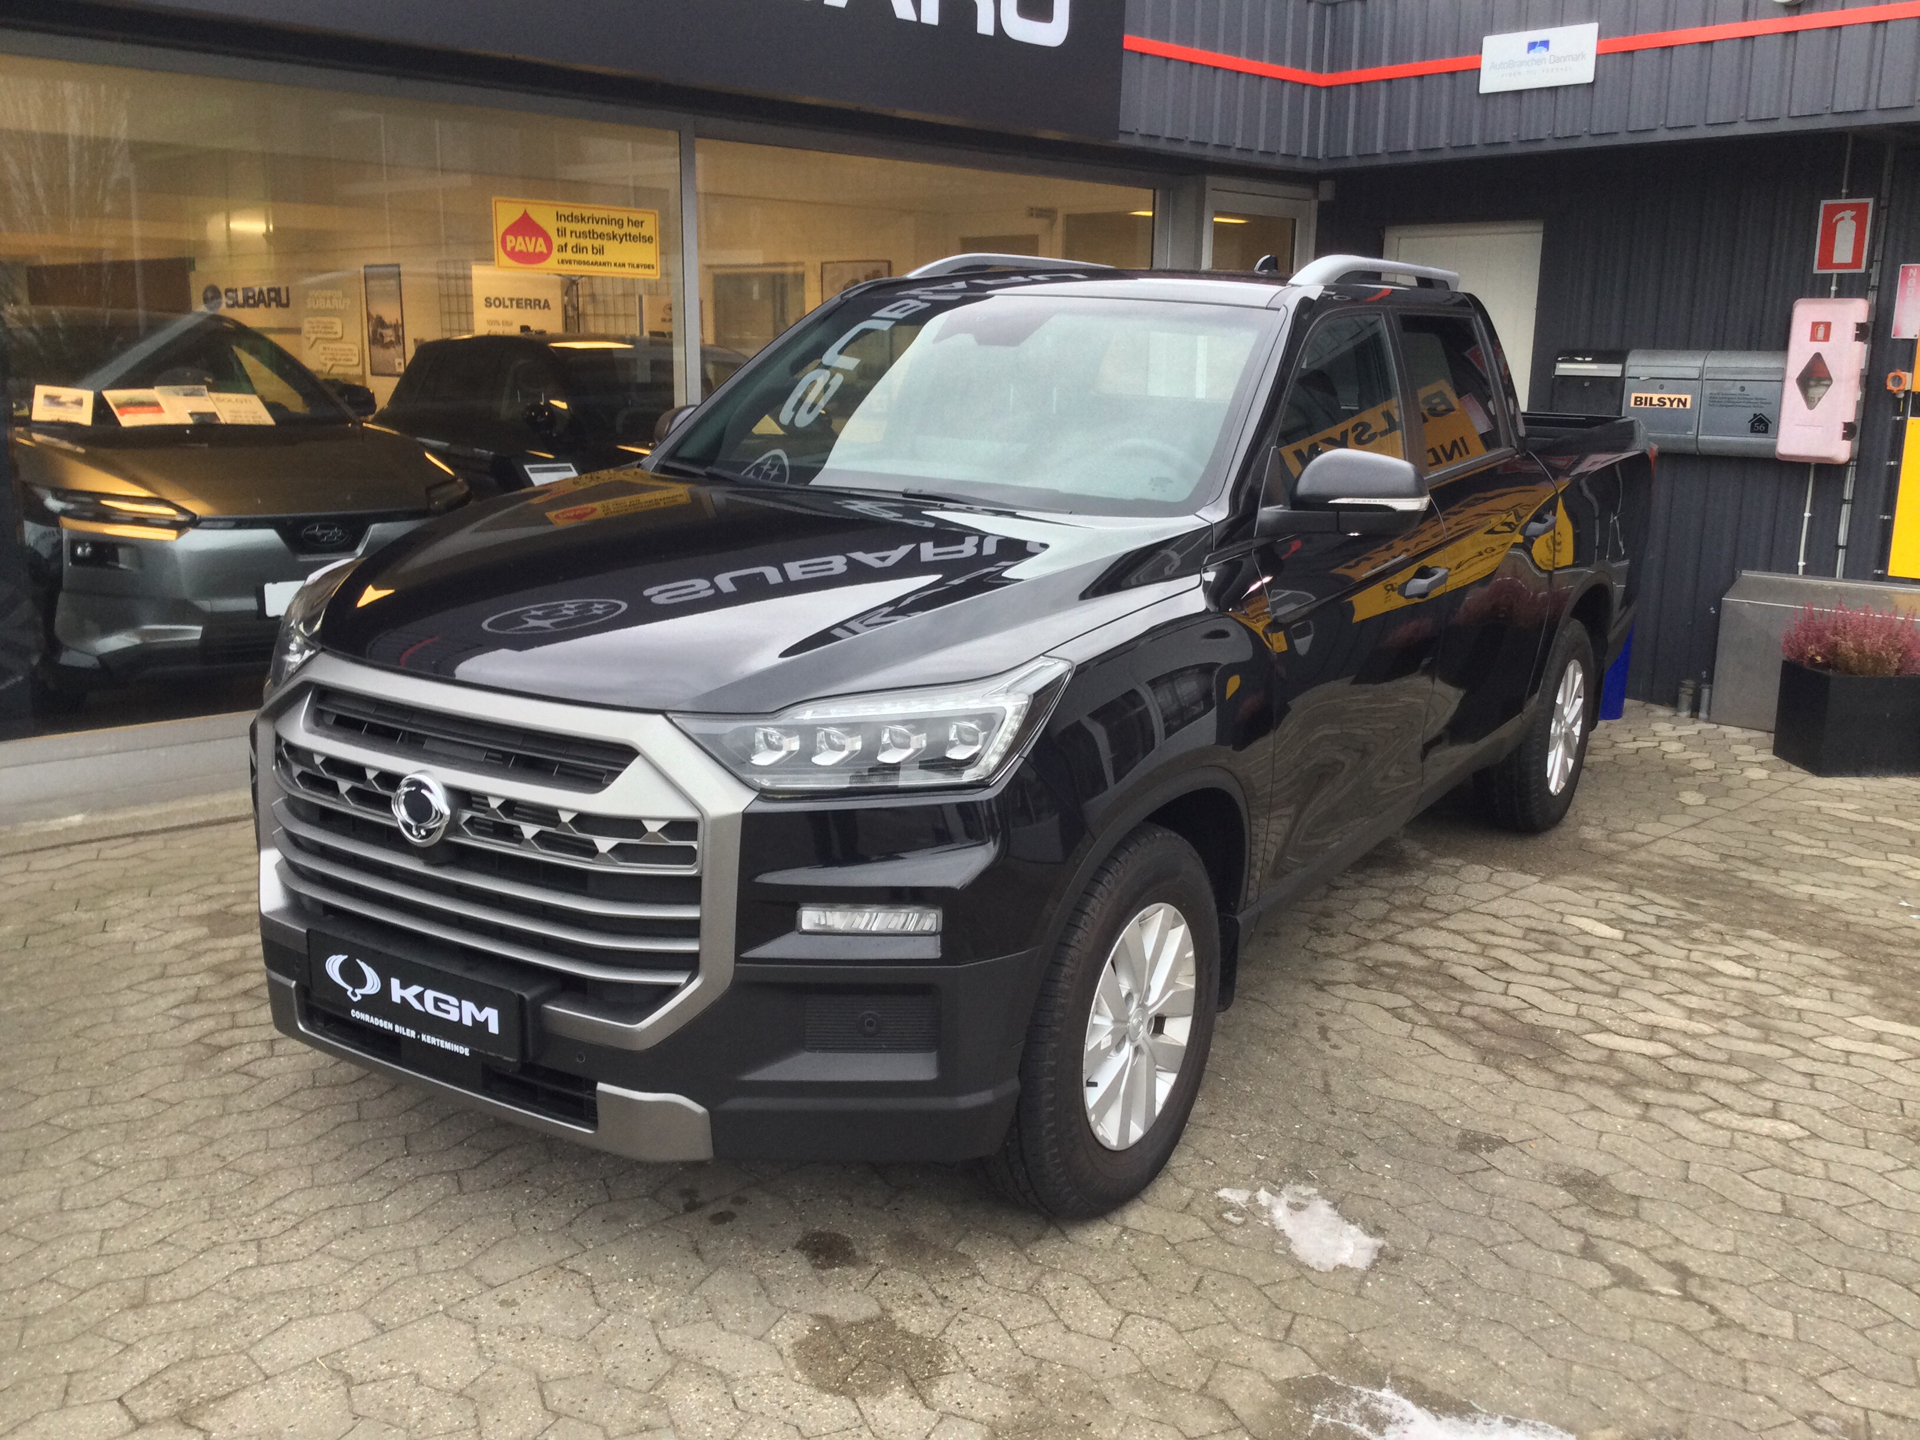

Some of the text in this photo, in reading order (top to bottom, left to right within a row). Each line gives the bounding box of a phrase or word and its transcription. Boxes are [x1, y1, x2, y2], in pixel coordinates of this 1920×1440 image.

[1489, 52, 1587, 70] AutoBranchen Danmark
[556, 211, 645, 229] Indskrivning her
[506, 235, 548, 254] PAVA
[556, 228, 654, 244] til rustbeskyttelse
[557, 243, 605, 256] af din bil
[557, 259, 612, 267] LEVETIDSGARANTI
[224, 286, 290, 309] SUBARU
[484, 297, 551, 310] SOLTERRA
[1633, 396, 1688, 408] BILSYN
[1753, 422, 1766, 431] 56
[391, 977, 499, 1035] KGM
[350, 1009, 470, 1056] CONRADSEN BILER KERTEMINDE
